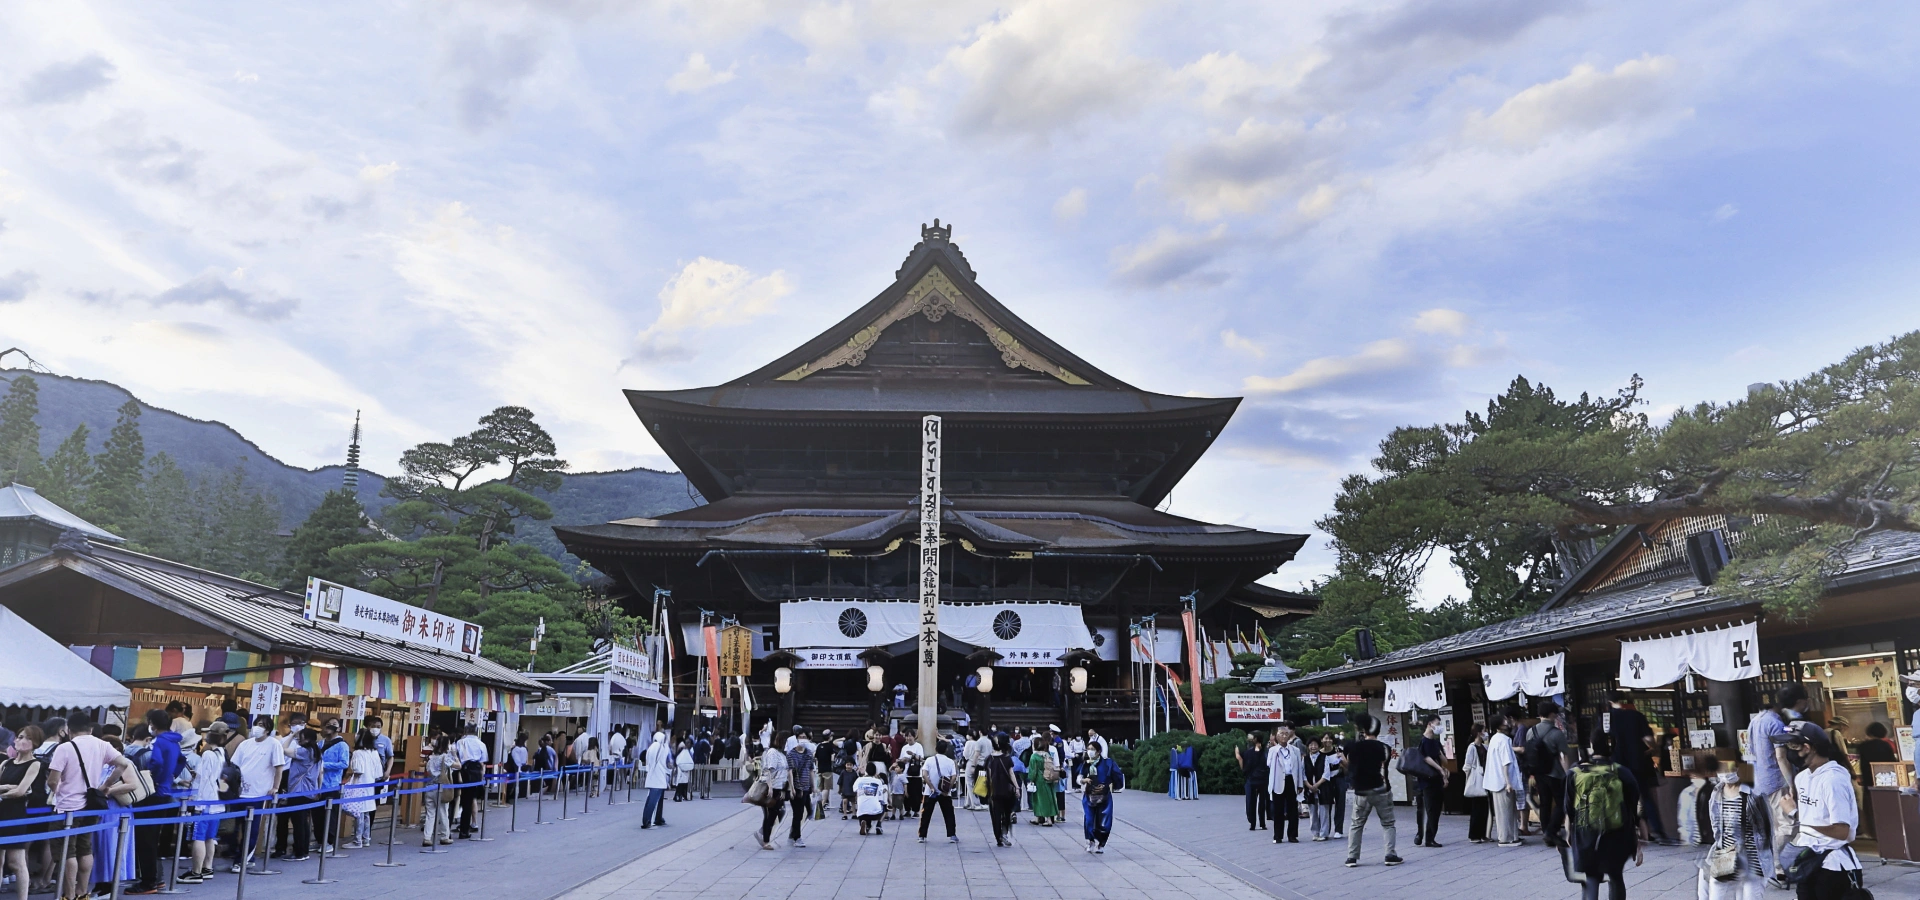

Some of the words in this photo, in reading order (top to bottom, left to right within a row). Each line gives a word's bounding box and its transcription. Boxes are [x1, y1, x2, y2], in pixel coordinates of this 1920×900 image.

[402, 609, 455, 646] 御朱印所
[256, 683, 268, 712] 御朱印
